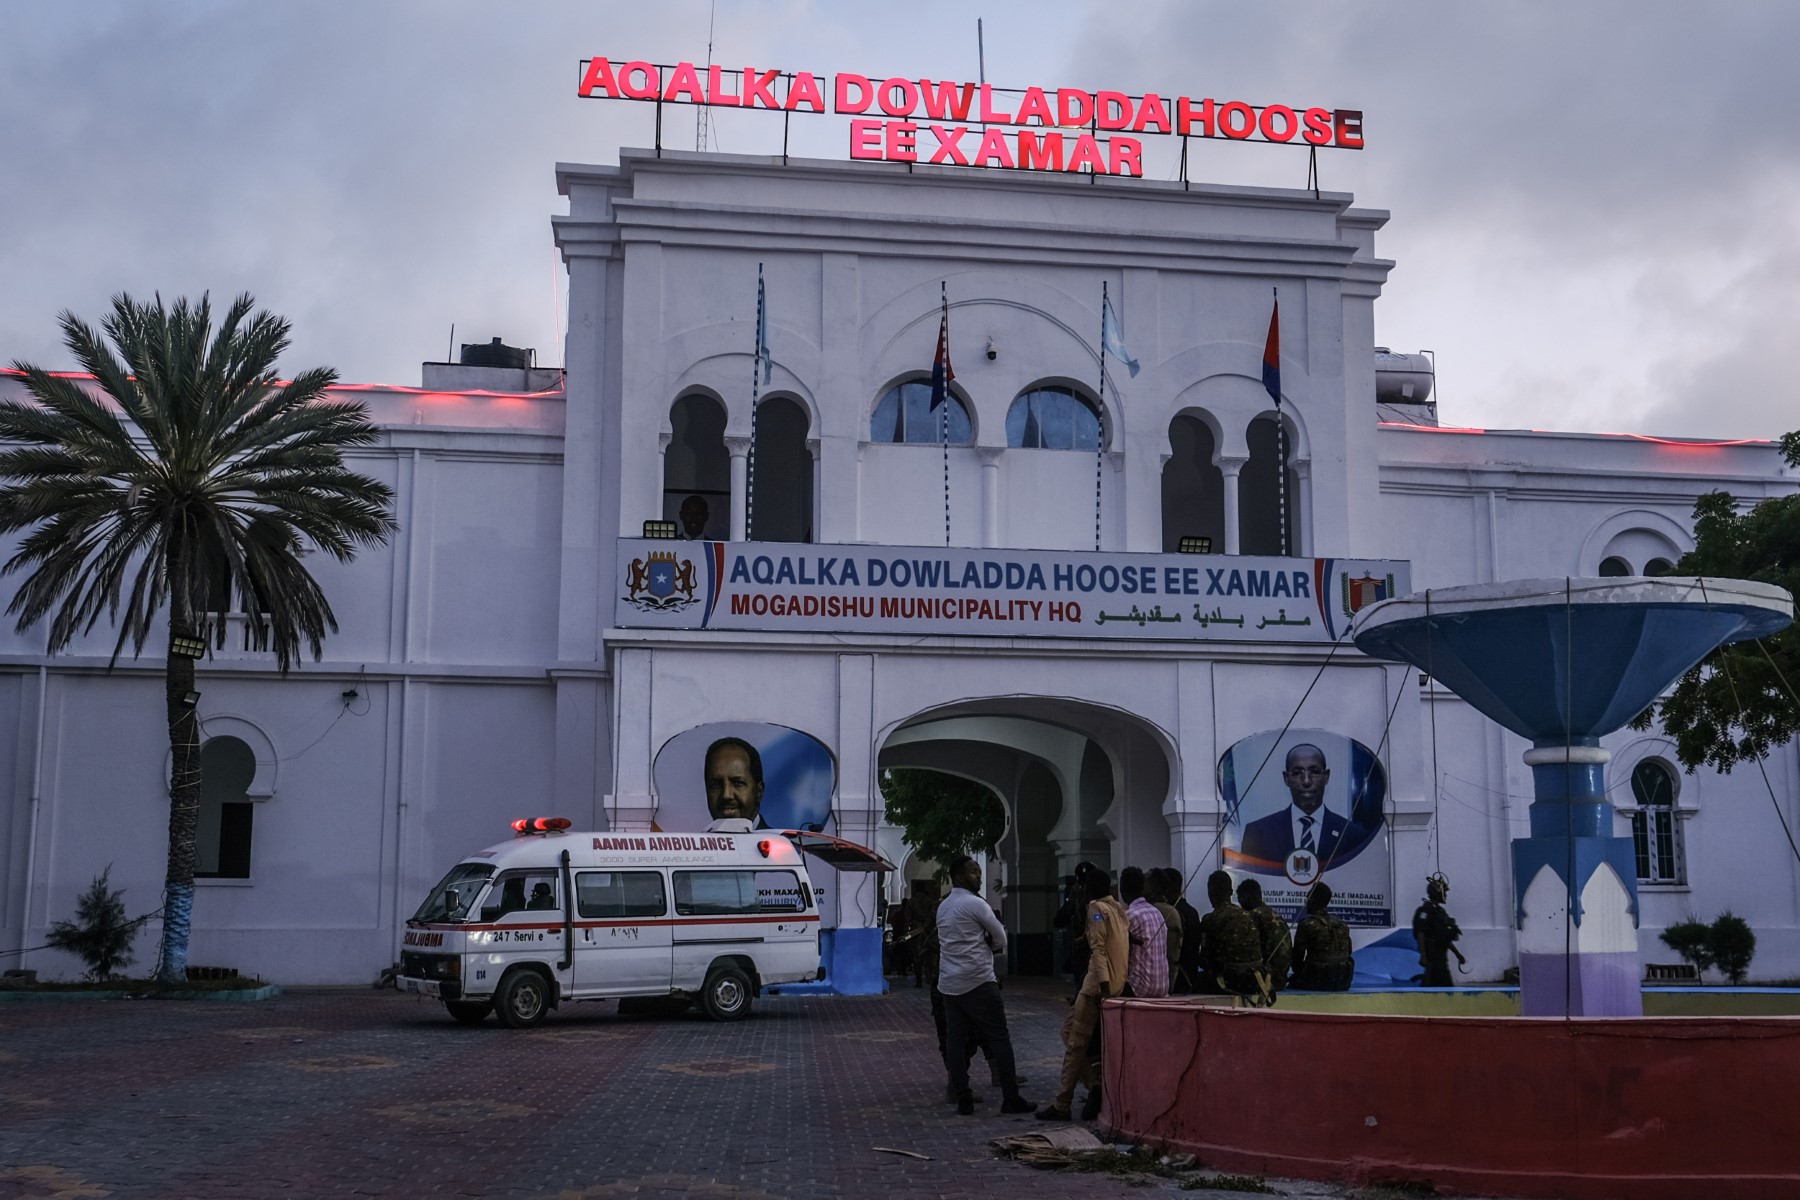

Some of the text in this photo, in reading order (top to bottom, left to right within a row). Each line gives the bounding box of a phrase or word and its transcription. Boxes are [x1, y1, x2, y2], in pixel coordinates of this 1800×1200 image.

[579, 56, 1364, 149] AQALKA DOWLADDA HOOSE
[850, 119, 1142, 177] EE XAMAR
[729, 555, 1310, 598] AQALKA DOWLADDA HOOSE EE XAMAR
[730, 593, 1081, 623] MOGADISHU MUNICIPALITY HQ
[592, 837, 736, 851] AAMIN AMBULANCE
[662, 855, 715, 863] AMBULANCE
